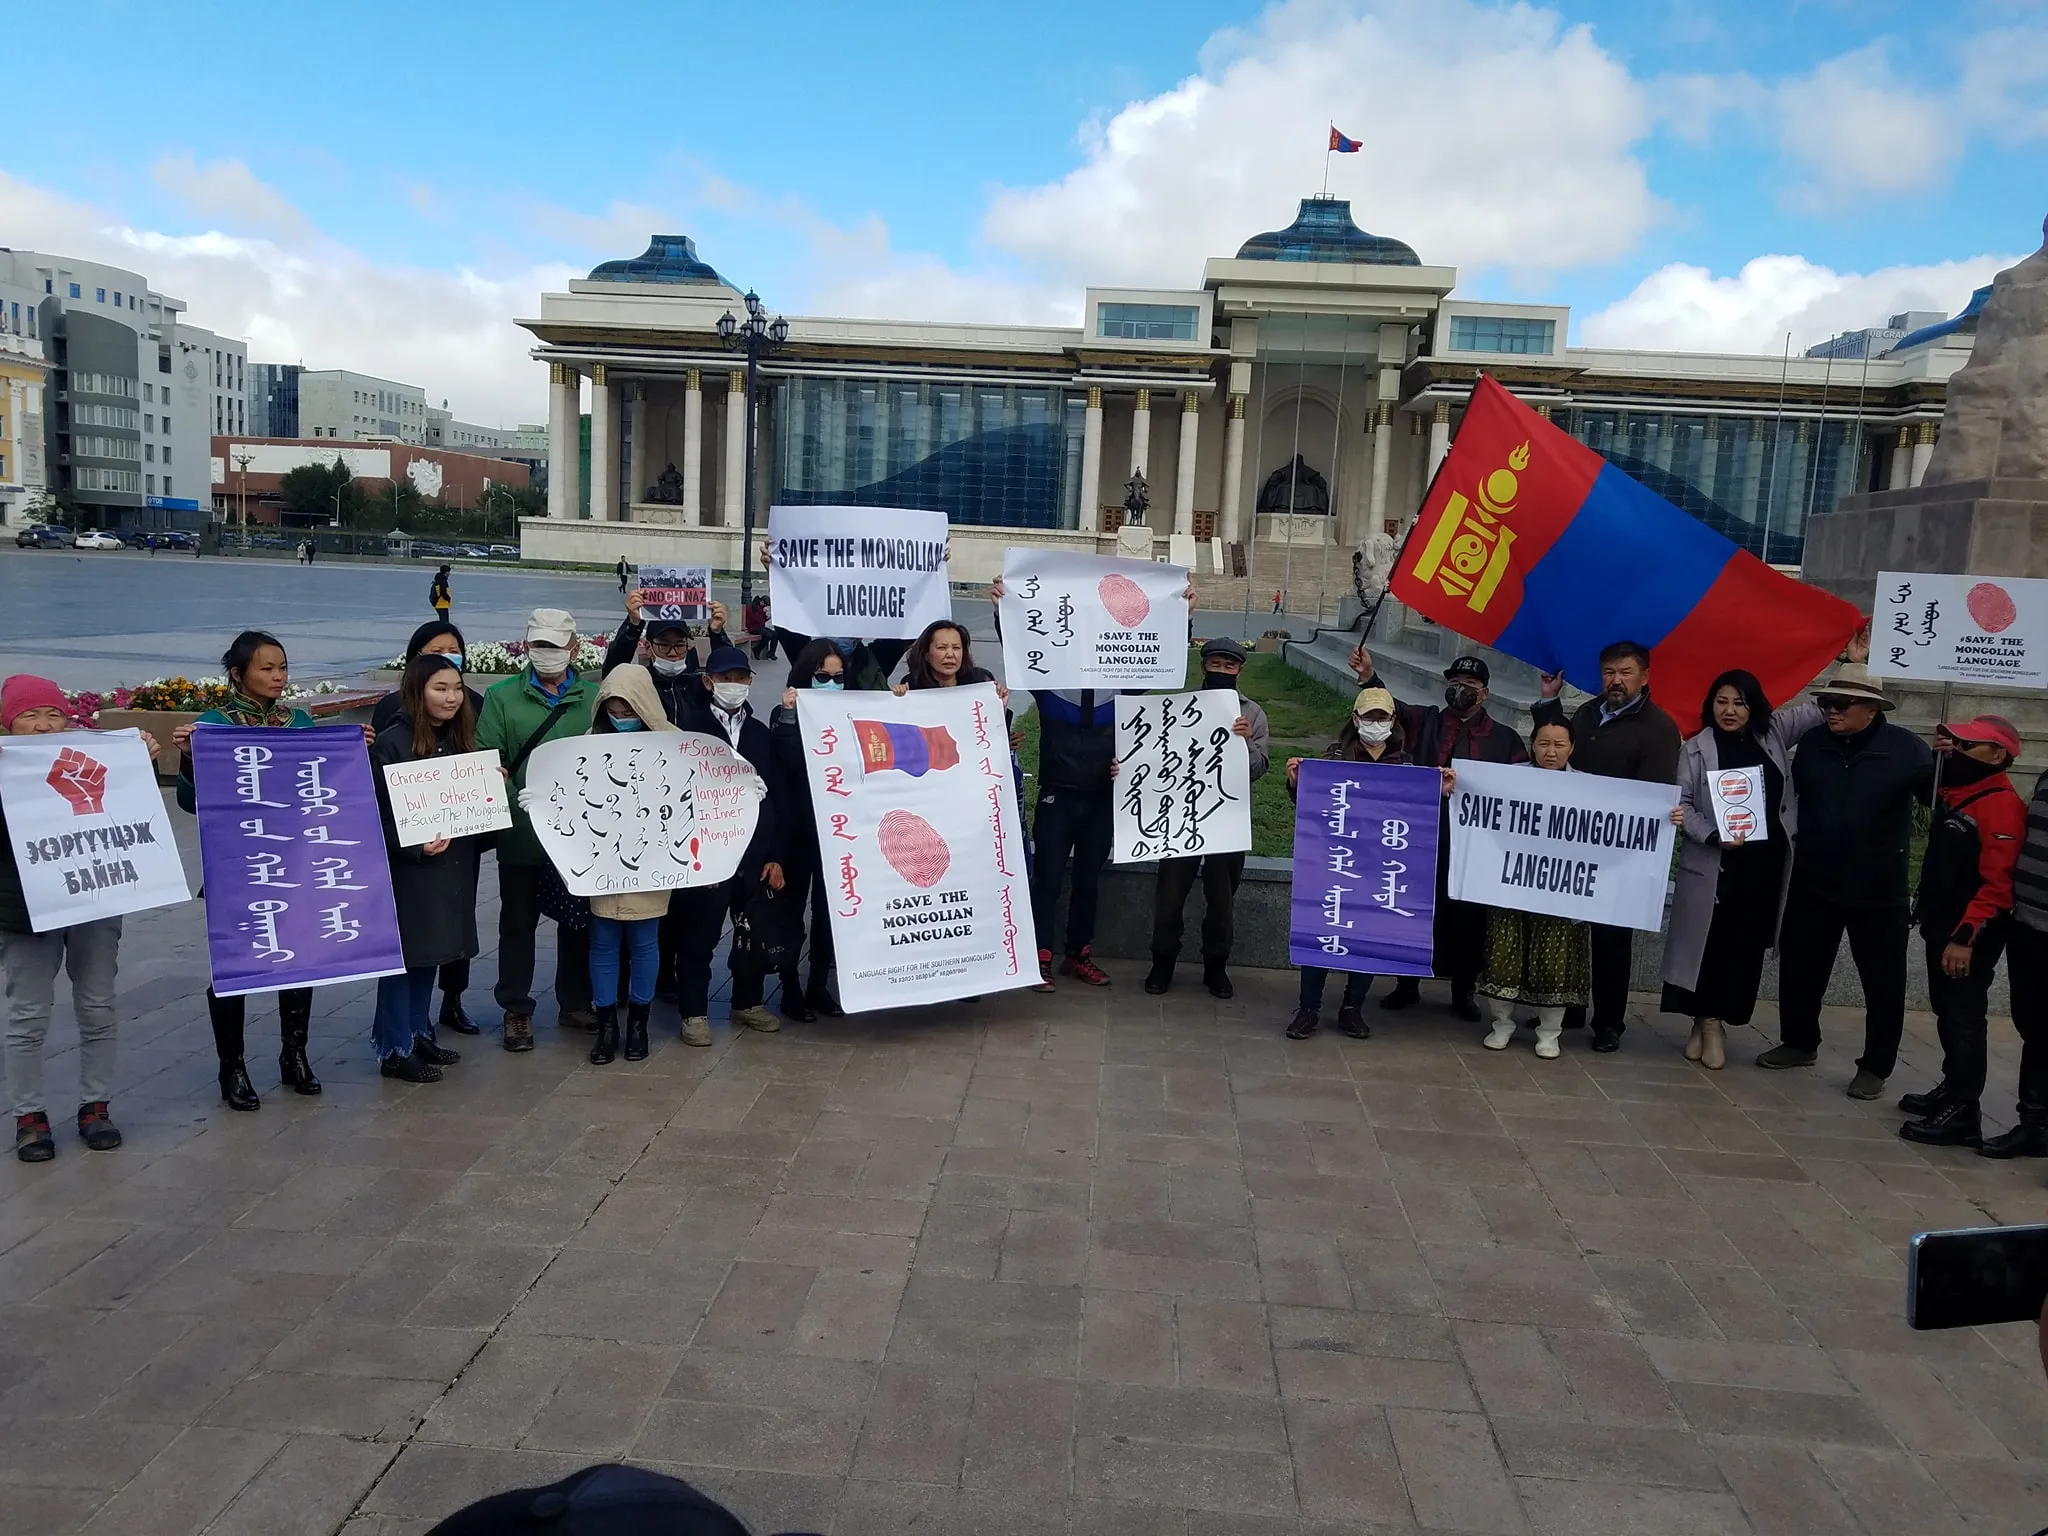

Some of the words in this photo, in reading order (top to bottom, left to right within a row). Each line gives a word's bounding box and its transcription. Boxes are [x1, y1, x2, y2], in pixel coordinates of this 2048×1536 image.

[779, 538, 819, 568] SAVE
[825, 538, 855, 568] THE
[861, 537, 943, 572] MONGOLIAN
[827, 584, 906, 618] LANGUAGE
[1138, 632, 1159, 641] THE
[2000, 638, 2024, 646] THE
[1095, 644, 1160, 653] MONGOLIAN
[1955, 646, 2025, 657] MONGOLIAN
[1098, 656, 1158, 665] LANGUAGE
[1957, 656, 2021, 668] LANGUAGE
[679, 738, 726, 758] #Save
[389, 768, 441, 787] Chinese
[450, 760, 485, 780] don't
[403, 791, 428, 812] bull
[695, 785, 746, 806] language
[713, 806, 743, 820] Inner
[1459, 792, 1503, 831] SAVE
[1509, 799, 1544, 837] THE
[1547, 805, 1660, 853] MONGOLIAN
[450, 821, 493, 835] language
[700, 823, 745, 847] Mongolia
[63, 857, 140, 896] БАЙНА
[595, 873, 640, 892] China
[1501, 851, 1598, 898] LANGUAGE
[885, 894, 932, 911] #SAVE
[939, 890, 969, 904] THE
[882, 907, 973, 929] MONGOLIAN
[889, 924, 973, 946] LANGUAGE
[888, 965, 906, 975] RIGHT
[907, 964, 918, 973] FOR
[919, 962, 930, 970] THE
[931, 959, 960, 969] SOUTHERN
